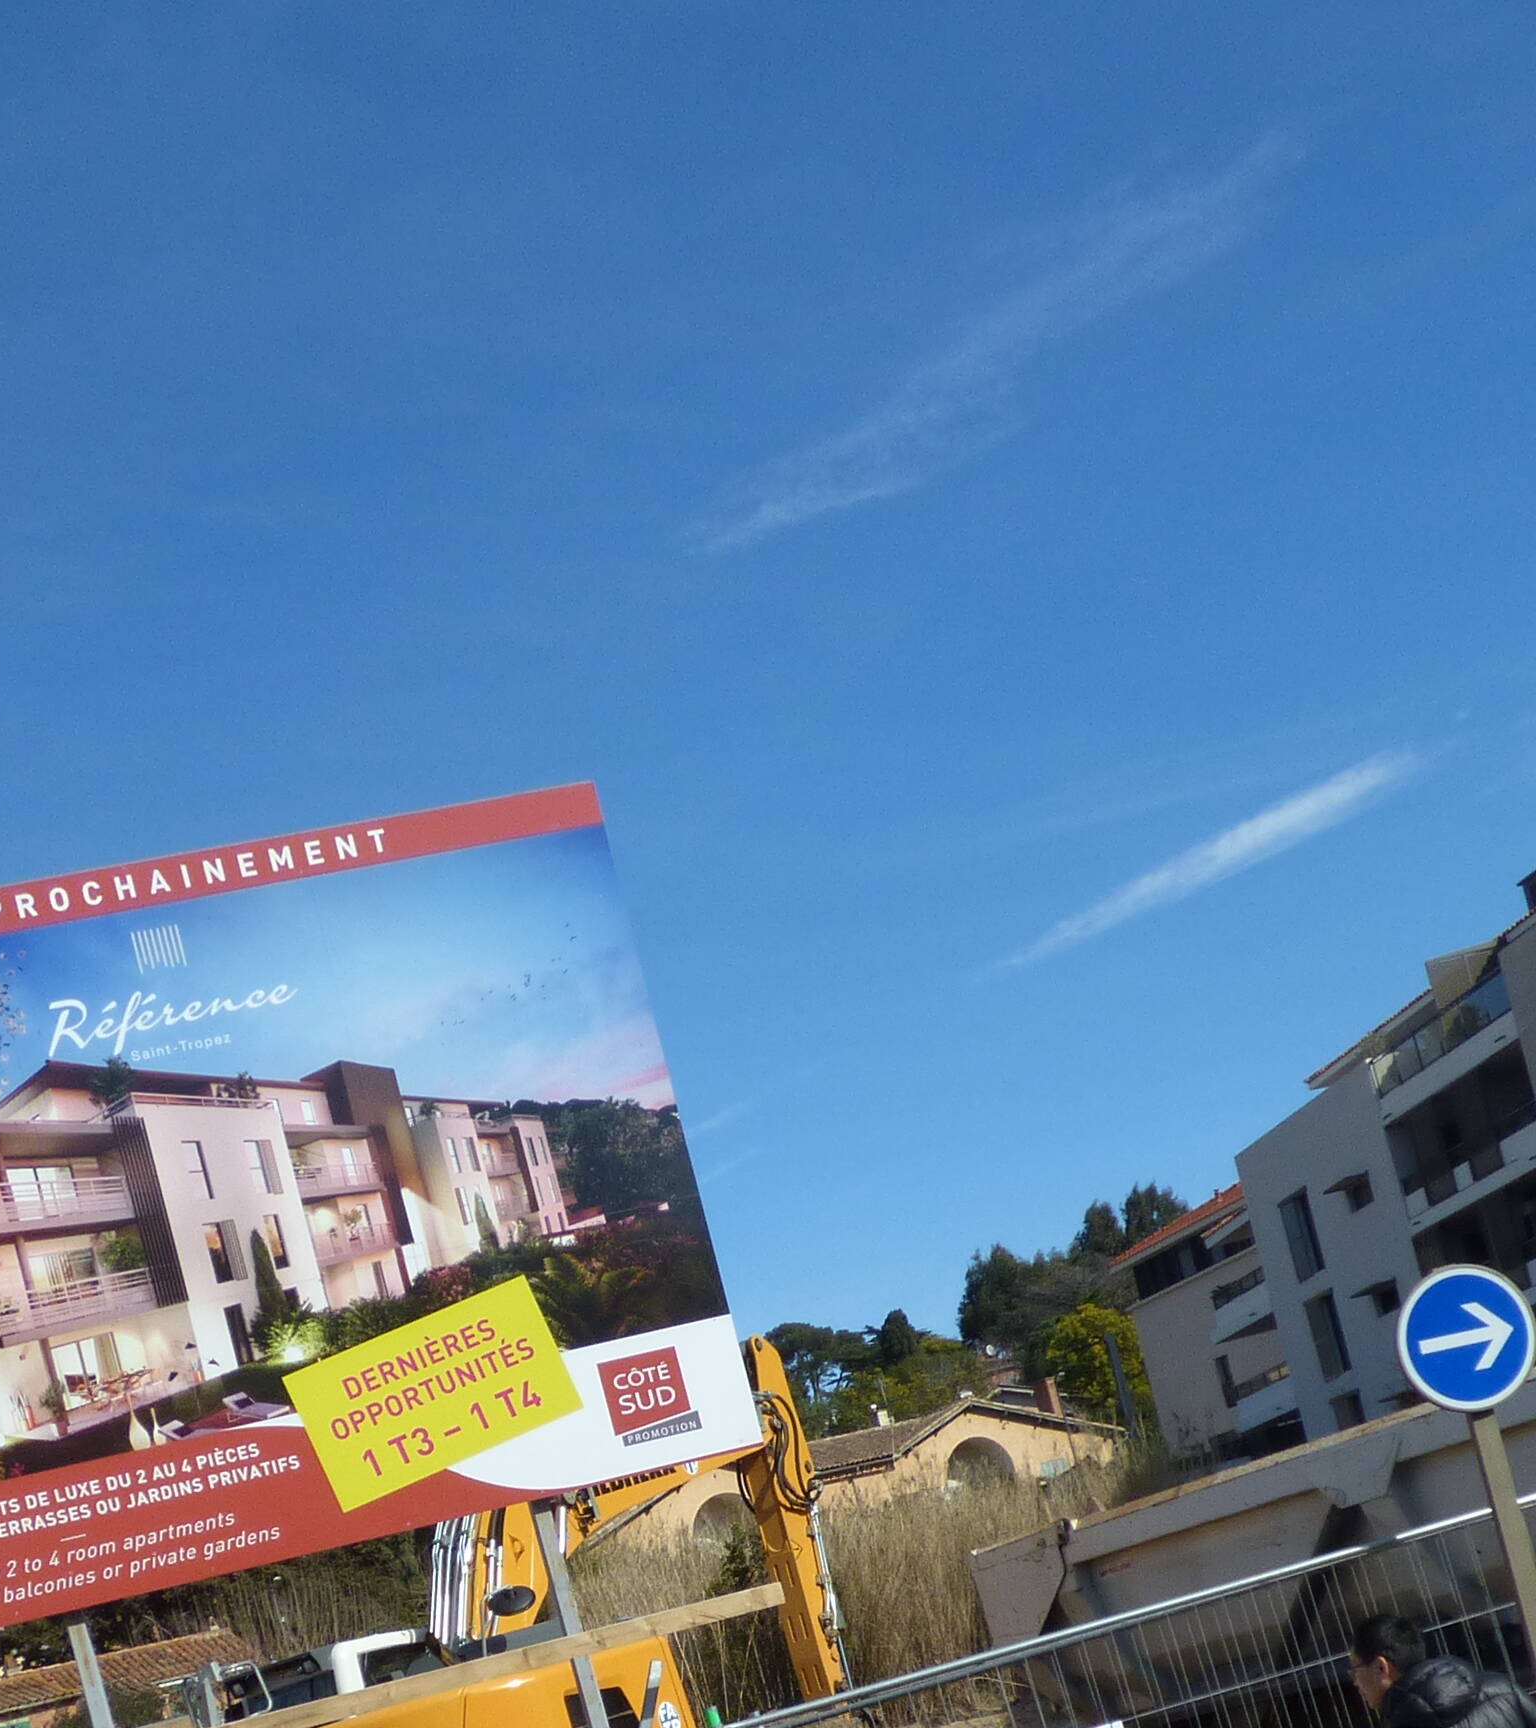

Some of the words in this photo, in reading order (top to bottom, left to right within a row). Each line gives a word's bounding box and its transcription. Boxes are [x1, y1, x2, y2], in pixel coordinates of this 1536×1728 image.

[48, 983, 299, 1058] Référence
[130, 1033, 232, 1063] Saint-Tropez
[330, 1337, 535, 1441] OPPORTUNITÉS
[341, 1318, 497, 1400] DERNIÈRES
[612, 1360, 672, 1391] CÔTÉ
[362, 1449, 382, 1477] 1
[387, 1426, 435, 1465] T3
[469, 1401, 490, 1430] 1
[495, 1379, 542, 1420] T4
[617, 1384, 677, 1415] SUD
[627, 1418, 698, 1446] PROMOTION
[25, 1491, 50, 1510] DE
[53, 1479, 102, 1503] LUXE
[106, 1472, 132, 1491] DU
[136, 1468, 148, 1485] 2
[152, 1462, 178, 1481] AU
[181, 1457, 193, 1474] 4
[196, 1442, 260, 1470] PIÈCES
[96, 1496, 121, 1516] OU
[126, 1478, 205, 1509] JARDINS
[208, 1454, 301, 1489] PRIVATIFS
[3, 1570, 97, 1604] balconies
[102, 1562, 124, 1580] or
[129, 1542, 198, 1579] private
[203, 1524, 282, 1561] gardens
[7, 1561, 18, 1578] 2
[24, 1556, 42, 1574] to
[49, 1550, 60, 1568] 4
[66, 1539, 117, 1564] room
[122, 1510, 236, 1555] apartments
